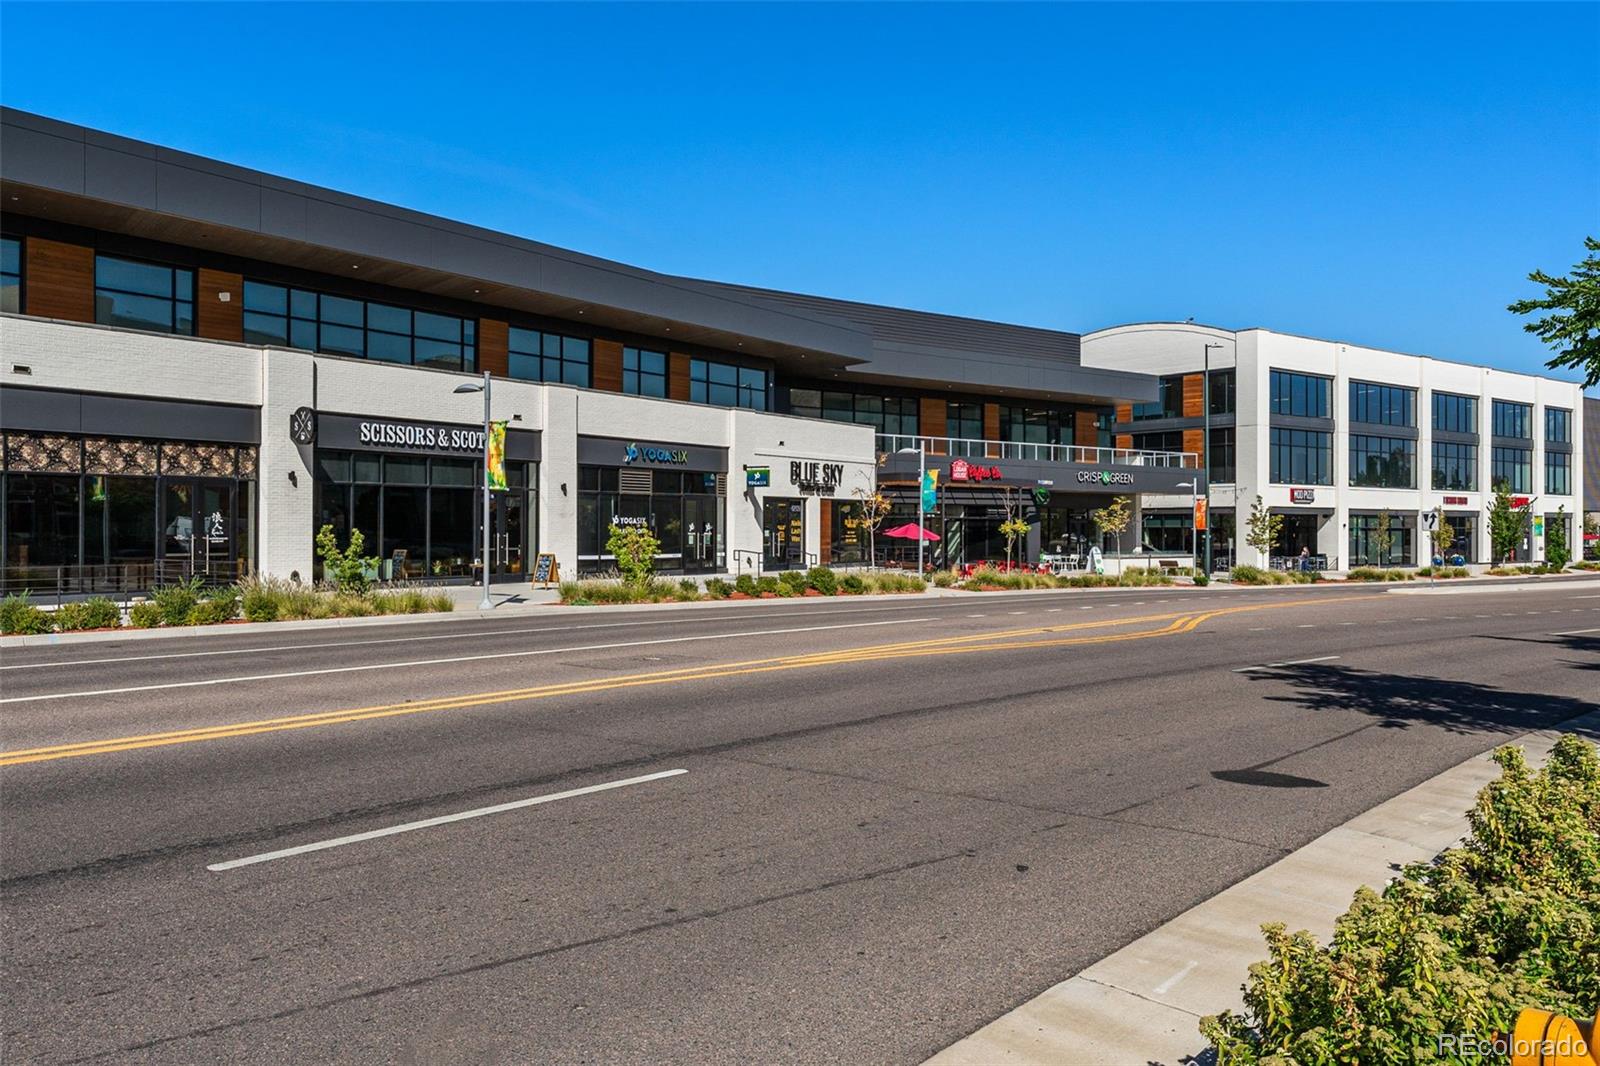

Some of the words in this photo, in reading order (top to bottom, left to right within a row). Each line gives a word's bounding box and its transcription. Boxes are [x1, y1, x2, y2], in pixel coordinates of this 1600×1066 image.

[360, 422, 435, 446] SCISSORS
[438, 428, 448, 447] &
[451, 430, 487, 449] SCOT
[641, 447, 688, 463] YOGASIX
[790, 461, 820, 484] BLUE
[822, 463, 844, 486] SKY
